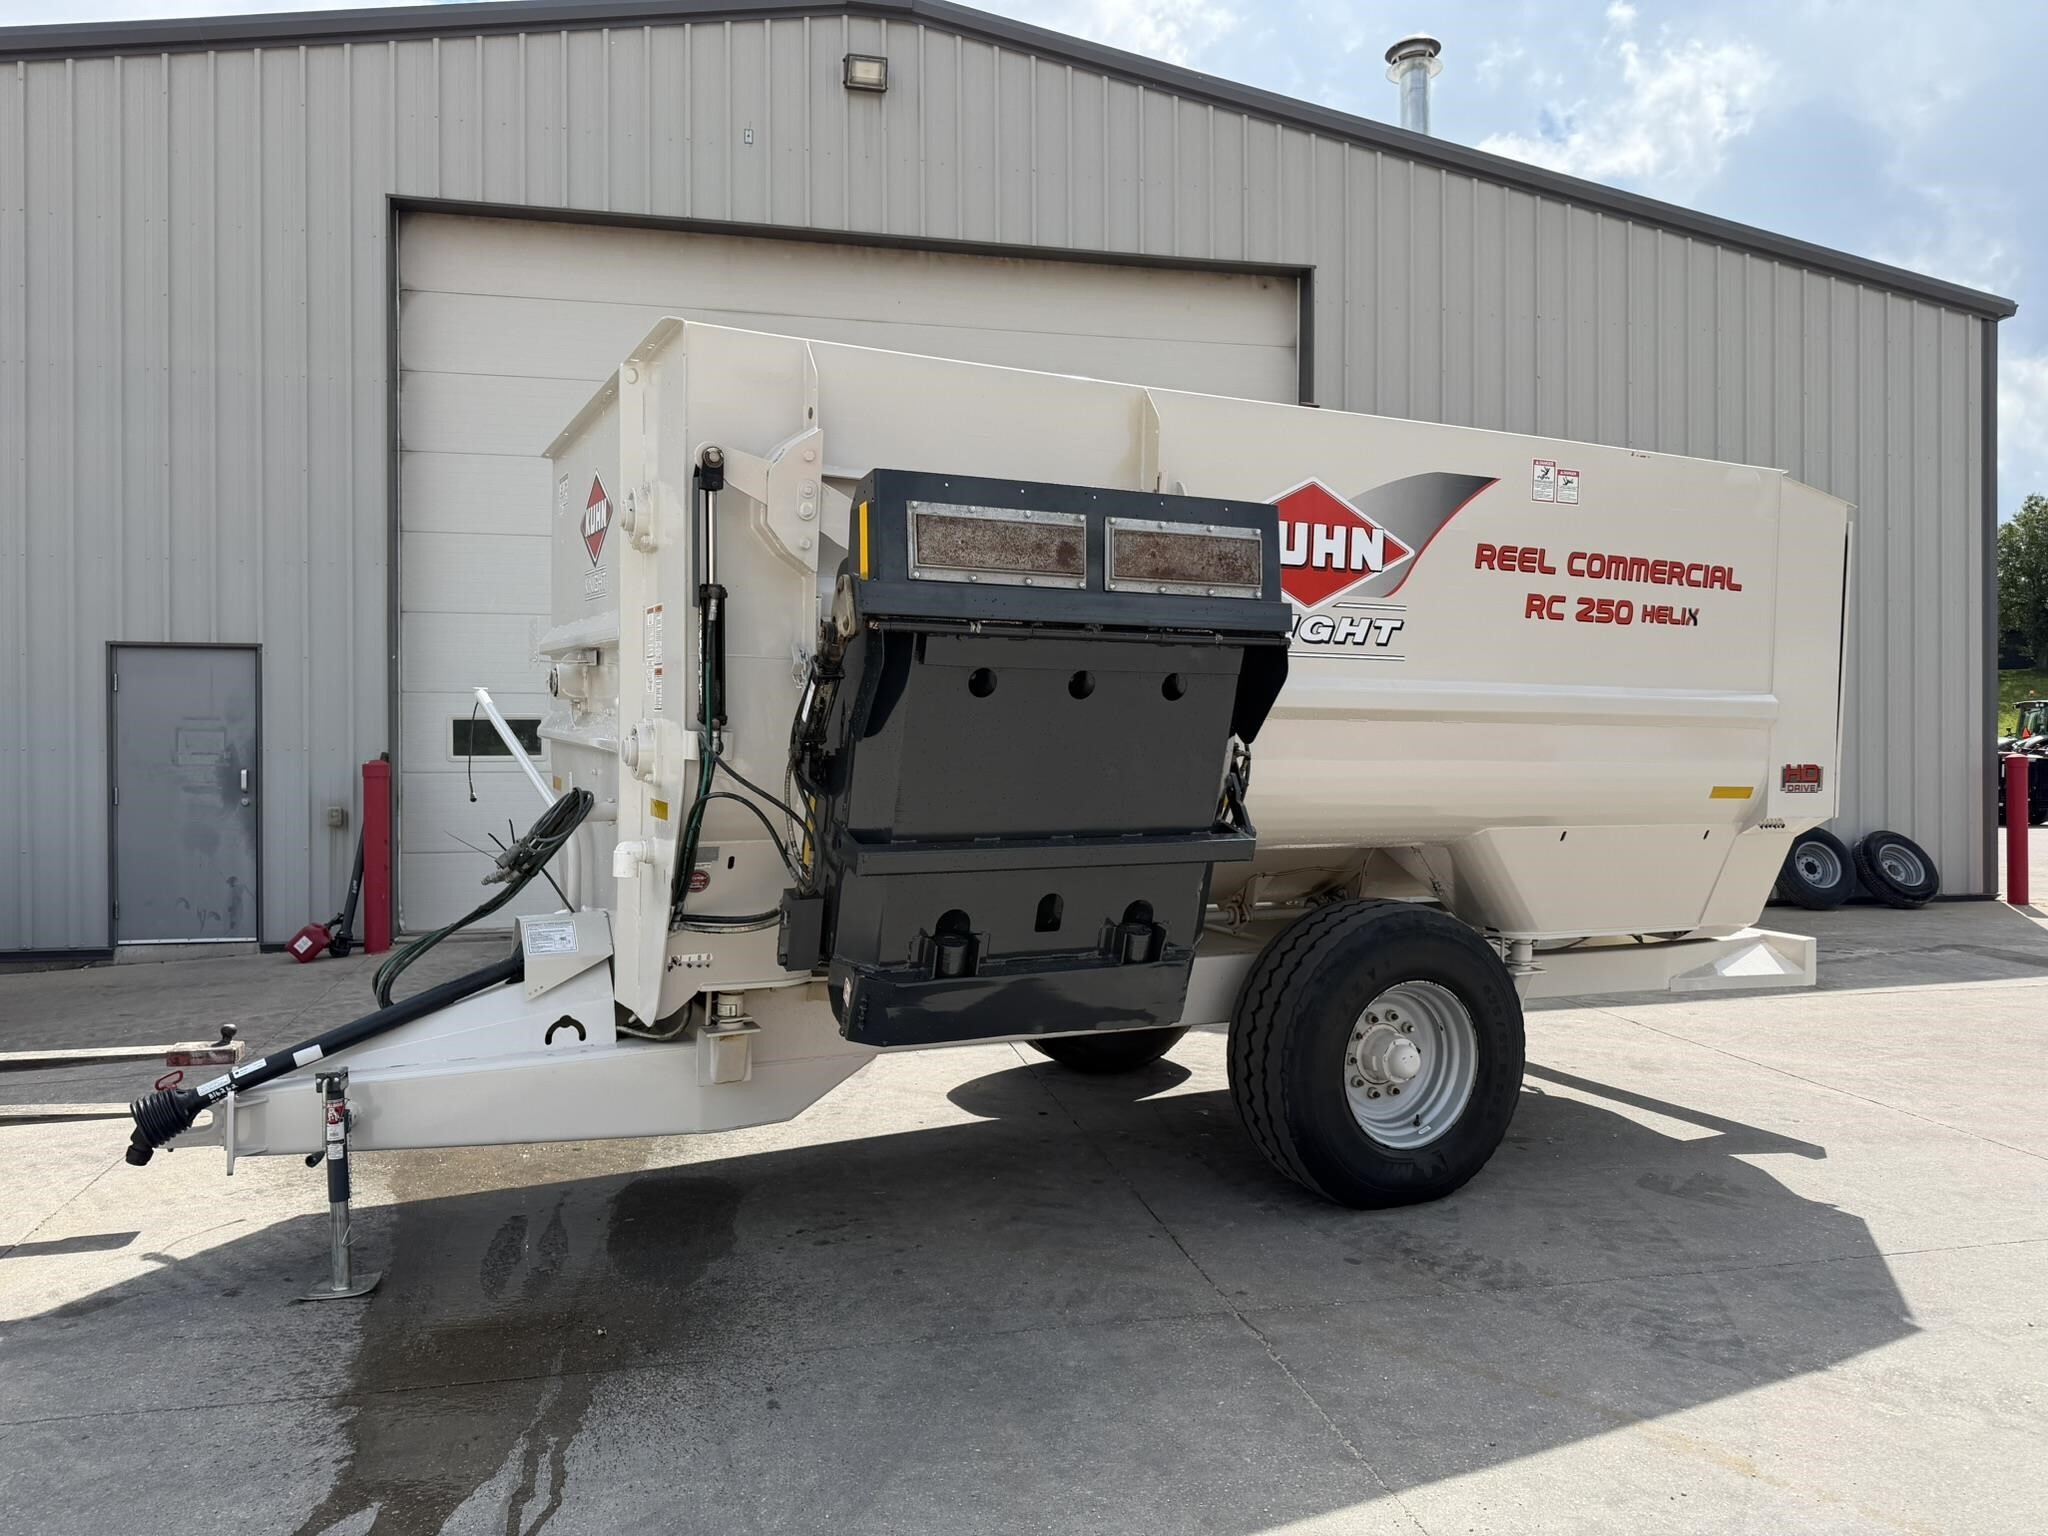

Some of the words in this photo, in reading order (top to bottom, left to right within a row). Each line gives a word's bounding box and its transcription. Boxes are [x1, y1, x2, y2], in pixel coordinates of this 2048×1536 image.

[585, 497, 607, 538] KUHN
[1279, 520, 1384, 572] UHN
[1474, 543, 1556, 575] REEL
[1567, 551, 1742, 592] COMMERCIAL
[1524, 593, 1567, 620] RC
[1575, 597, 1634, 625] 250
[1641, 604, 1700, 626] HELIX
[1785, 764, 1819, 783] HD
[1787, 784, 1816, 792] DRIVE
